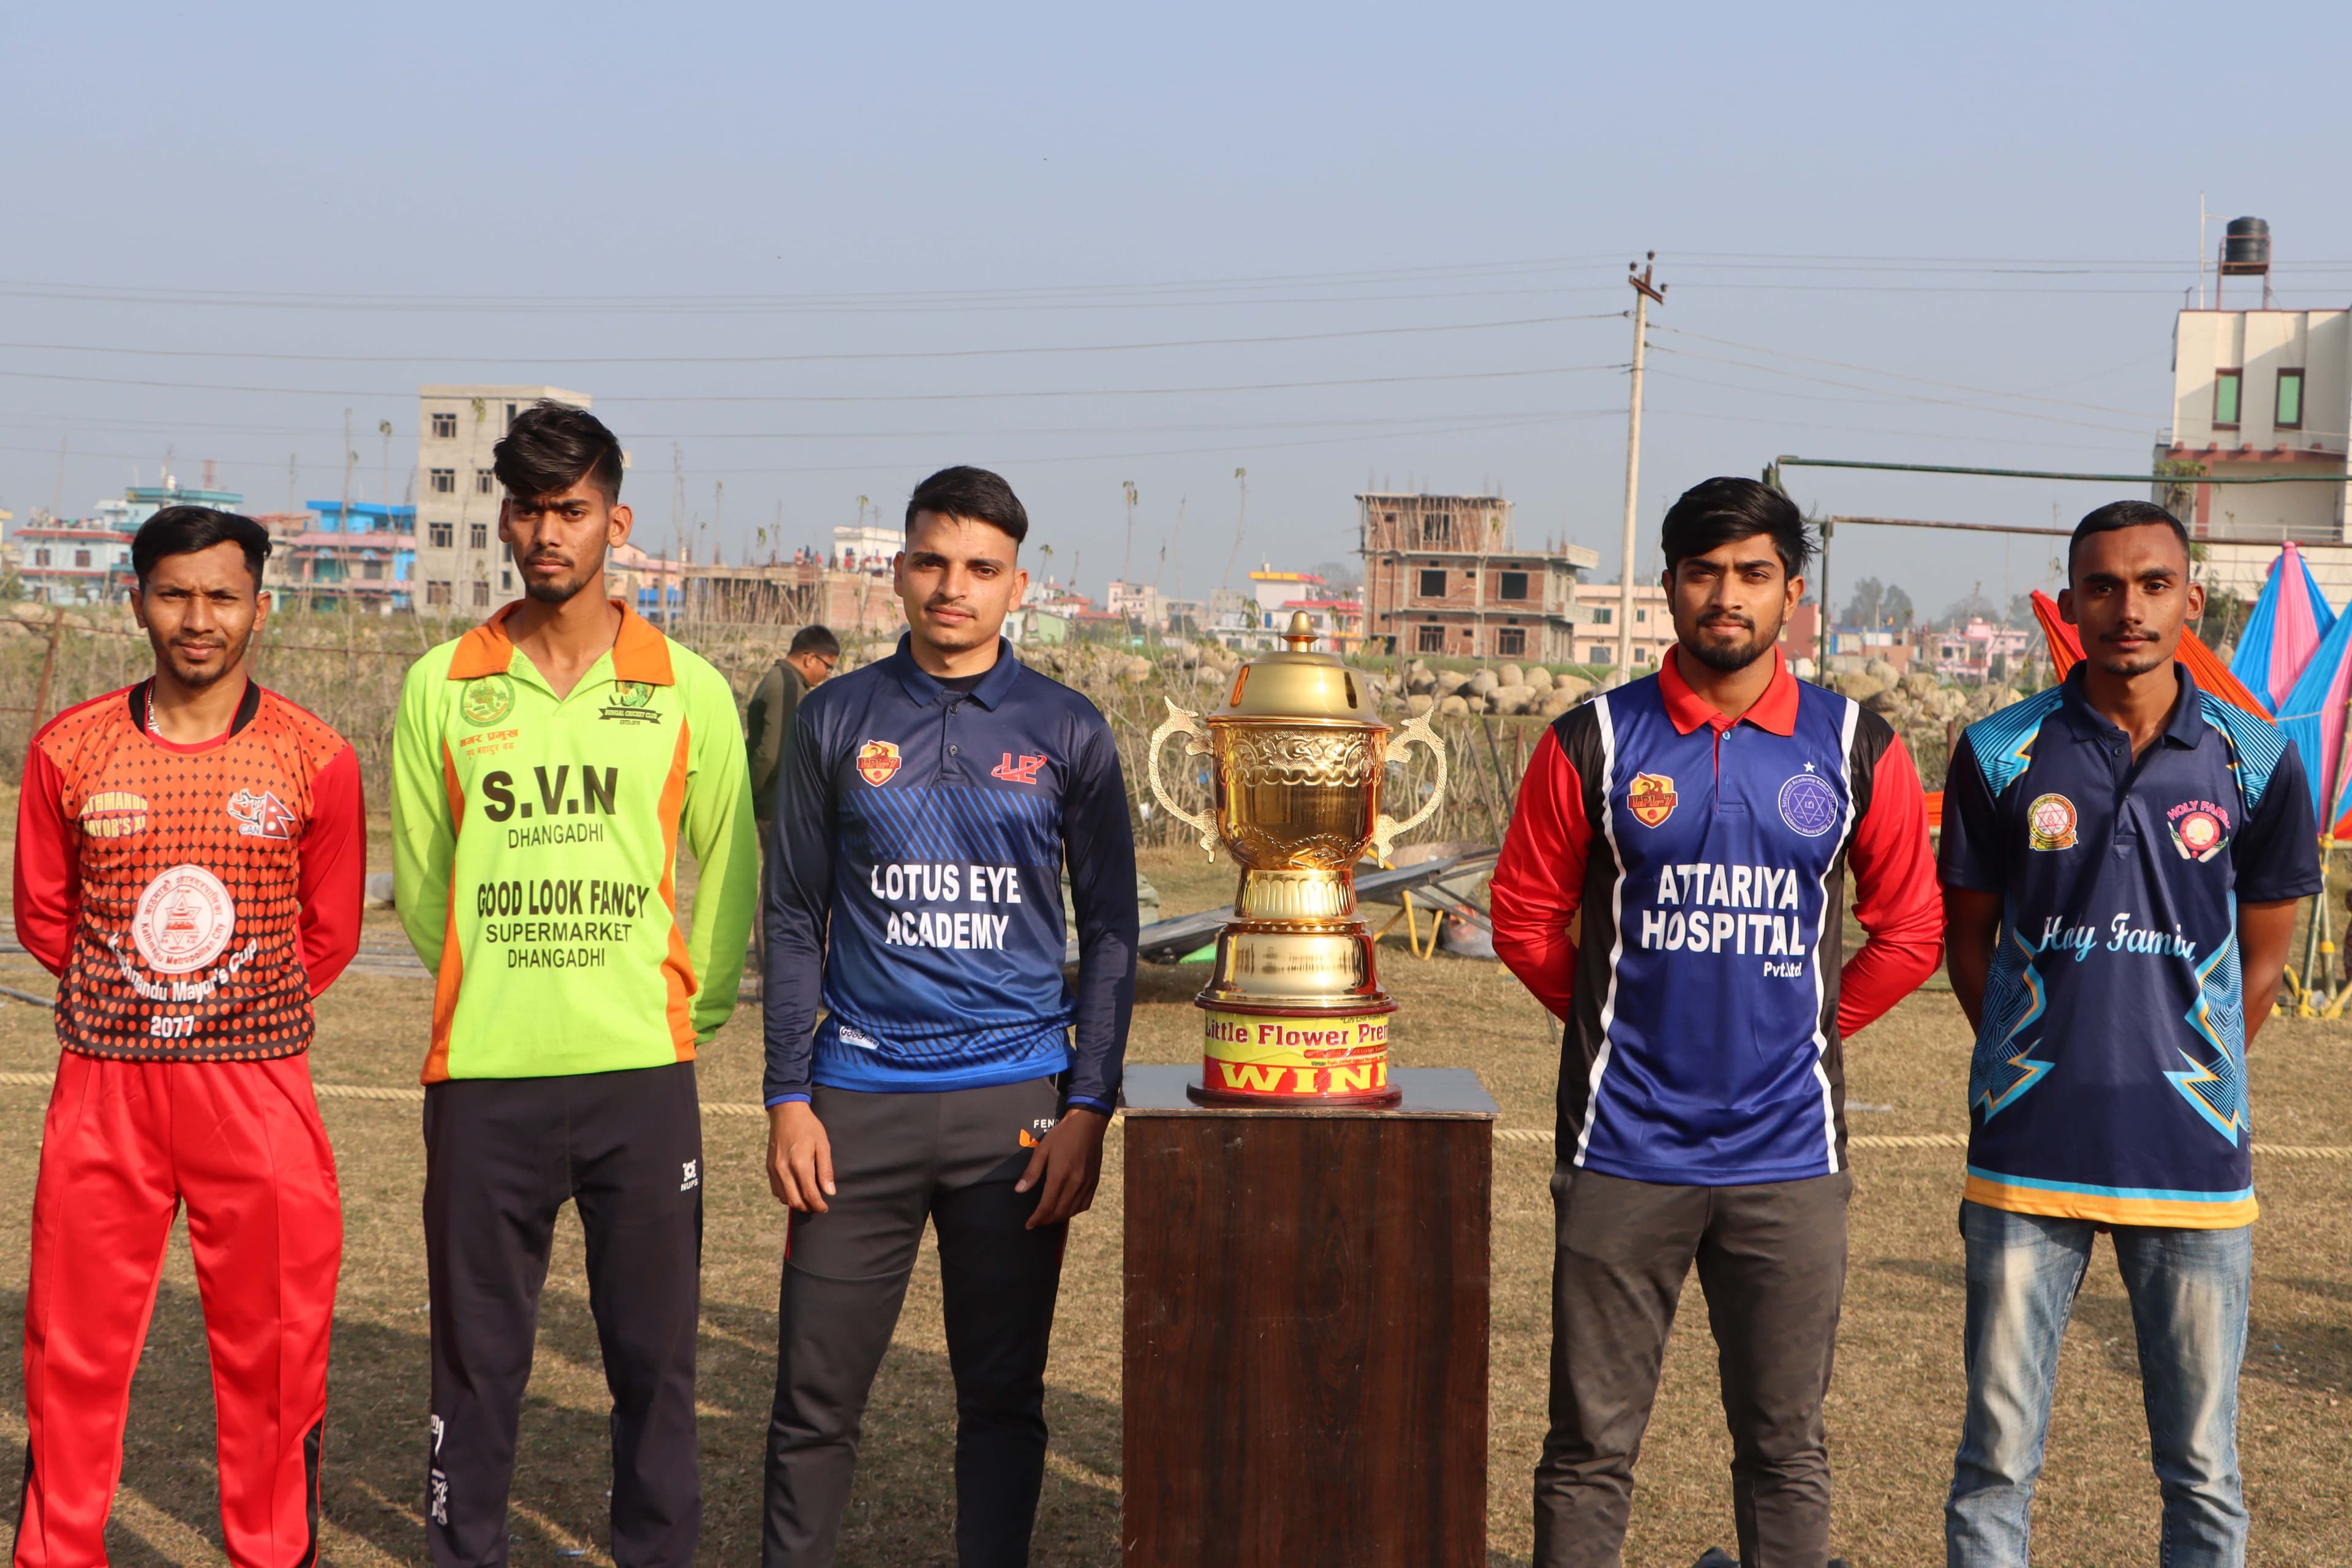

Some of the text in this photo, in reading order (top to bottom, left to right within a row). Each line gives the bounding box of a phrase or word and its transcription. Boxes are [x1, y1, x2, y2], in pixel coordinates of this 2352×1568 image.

[861, 758, 898, 769] LPL-7
[482, 764, 619, 823] S.V.N
[1792, 777, 1817, 786] Academy
[78, 791, 148, 818] ATHMANDU
[1632, 794, 1673, 808] LPL-7
[2166, 800, 2199, 821] HOLY
[239, 824, 261, 834] CAN
[508, 823, 603, 849] DHANGADHI
[871, 864, 1022, 903] LOTUS EYE
[1657, 862, 1798, 910] ATTARIYA
[478, 879, 650, 919] GOOD LOOK FANCY
[165, 941, 216, 965] Metropolitan
[212, 922, 227, 940] City
[486, 922, 632, 943] SUPERMARKET
[885, 911, 1009, 951] ACADEMY
[1642, 910, 1806, 956] HOSPITAL
[172, 968, 229, 1003] Mayor's
[228, 938, 258, 973] Cup
[508, 948, 605, 968] DHANGADHI
[150, 1014, 195, 1038] 2077
[1205, 1016, 1248, 1044] Little
[1257, 1023, 1350, 1047] Flower
[680, 1178, 698, 1192] NUPS
